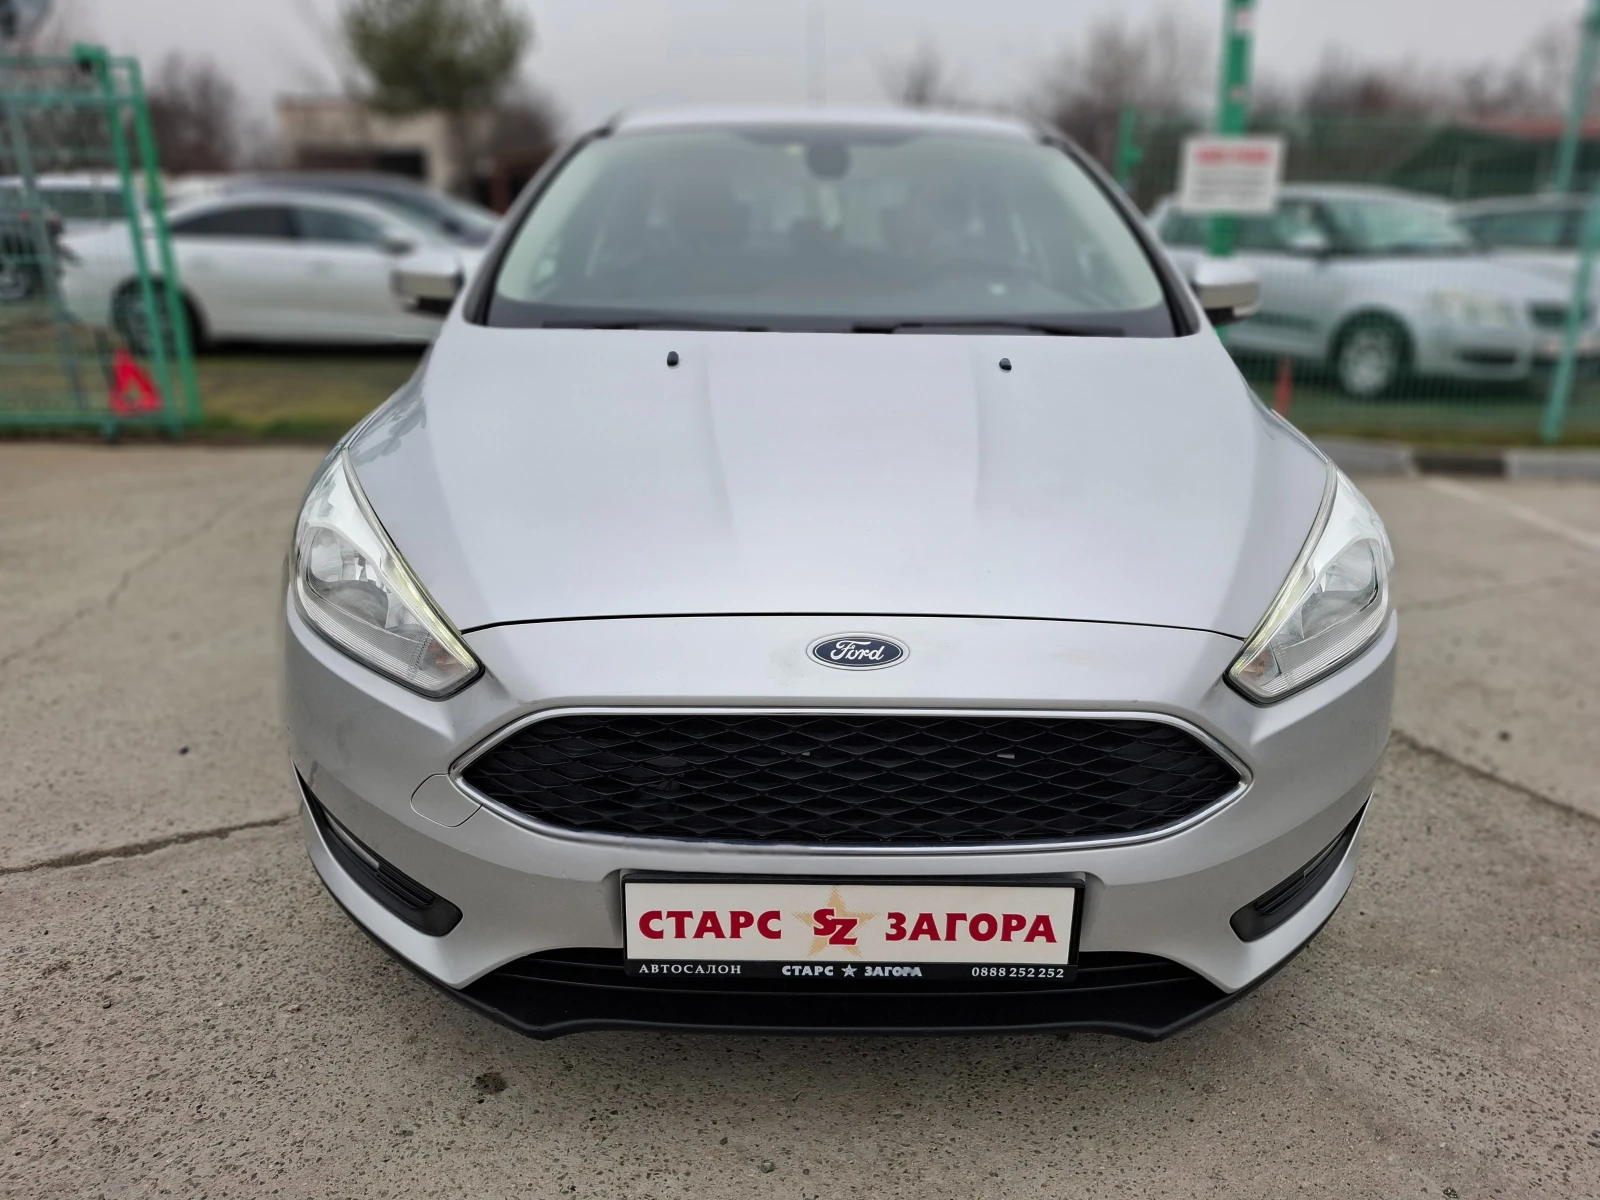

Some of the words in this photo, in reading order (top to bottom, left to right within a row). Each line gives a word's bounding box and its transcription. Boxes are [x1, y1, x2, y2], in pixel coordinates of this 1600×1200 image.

[830, 640, 884, 661] Ford
[638, 910, 782, 939] СТАРС
[813, 908, 858, 945] SZ
[885, 912, 1057, 943] ЗАГОРА
[639, 964, 741, 974] АВТОСАЛОН
[782, 966, 834, 976] СТАРС
[864, 966, 922, 977] ЗАГОРА
[971, 967, 1006, 977] 0888
